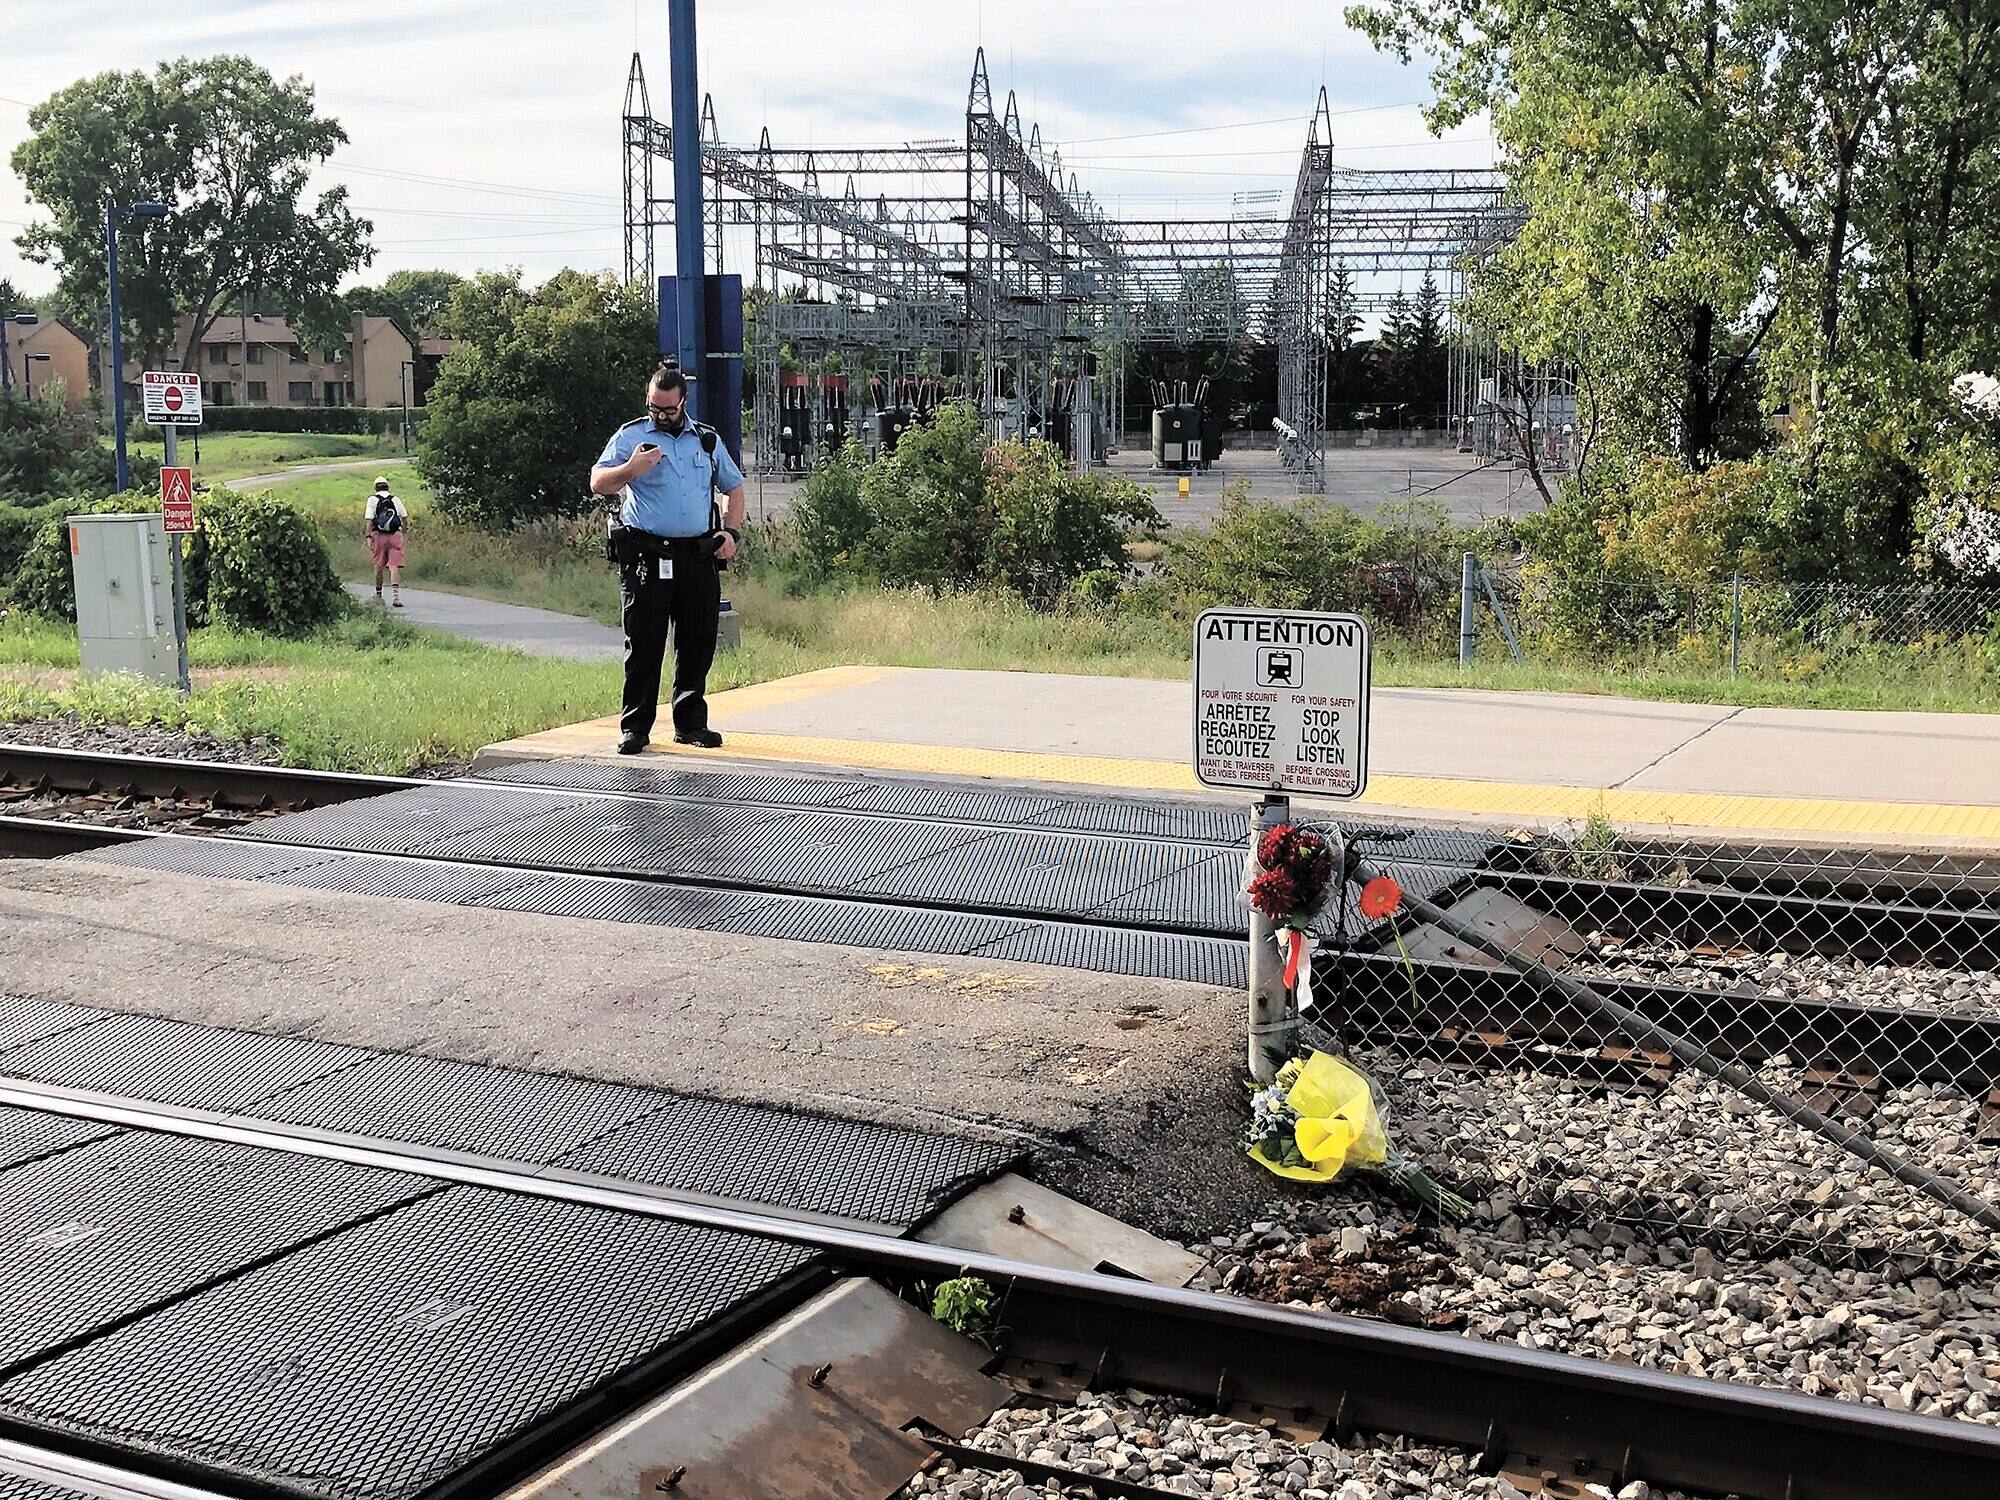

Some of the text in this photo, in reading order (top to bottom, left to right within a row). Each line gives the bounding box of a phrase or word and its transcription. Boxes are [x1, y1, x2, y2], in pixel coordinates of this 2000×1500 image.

[153, 374, 190, 384] DANGER
[165, 508, 192, 521] Danger
[1206, 619, 1353, 647] ATTENTION
[1201, 690, 1278, 702] POUR VOTRE SÉCURITÉ
[1292, 695, 1355, 708] FOR YOUR SAFETY
[1206, 703, 1271, 722] ARRÊTEZ
[1303, 709, 1340, 727] STOP
[1201, 720, 1276, 741] REGARDEZ
[1302, 727, 1341, 746] LOOK
[1206, 737, 1270, 759] ÉCOUTEZ
[1296, 745, 1344, 764] LISTEN
[1200, 758, 1274, 772] AVANT DE TRAVERSER
[1286, 765, 1350, 778] BEFORE CROSSING
[1204, 768, 1218, 777] LES
[1218, 769, 1237, 779] VOIES
[1281, 774, 1355, 790] THE RAILWAY TRACKS
